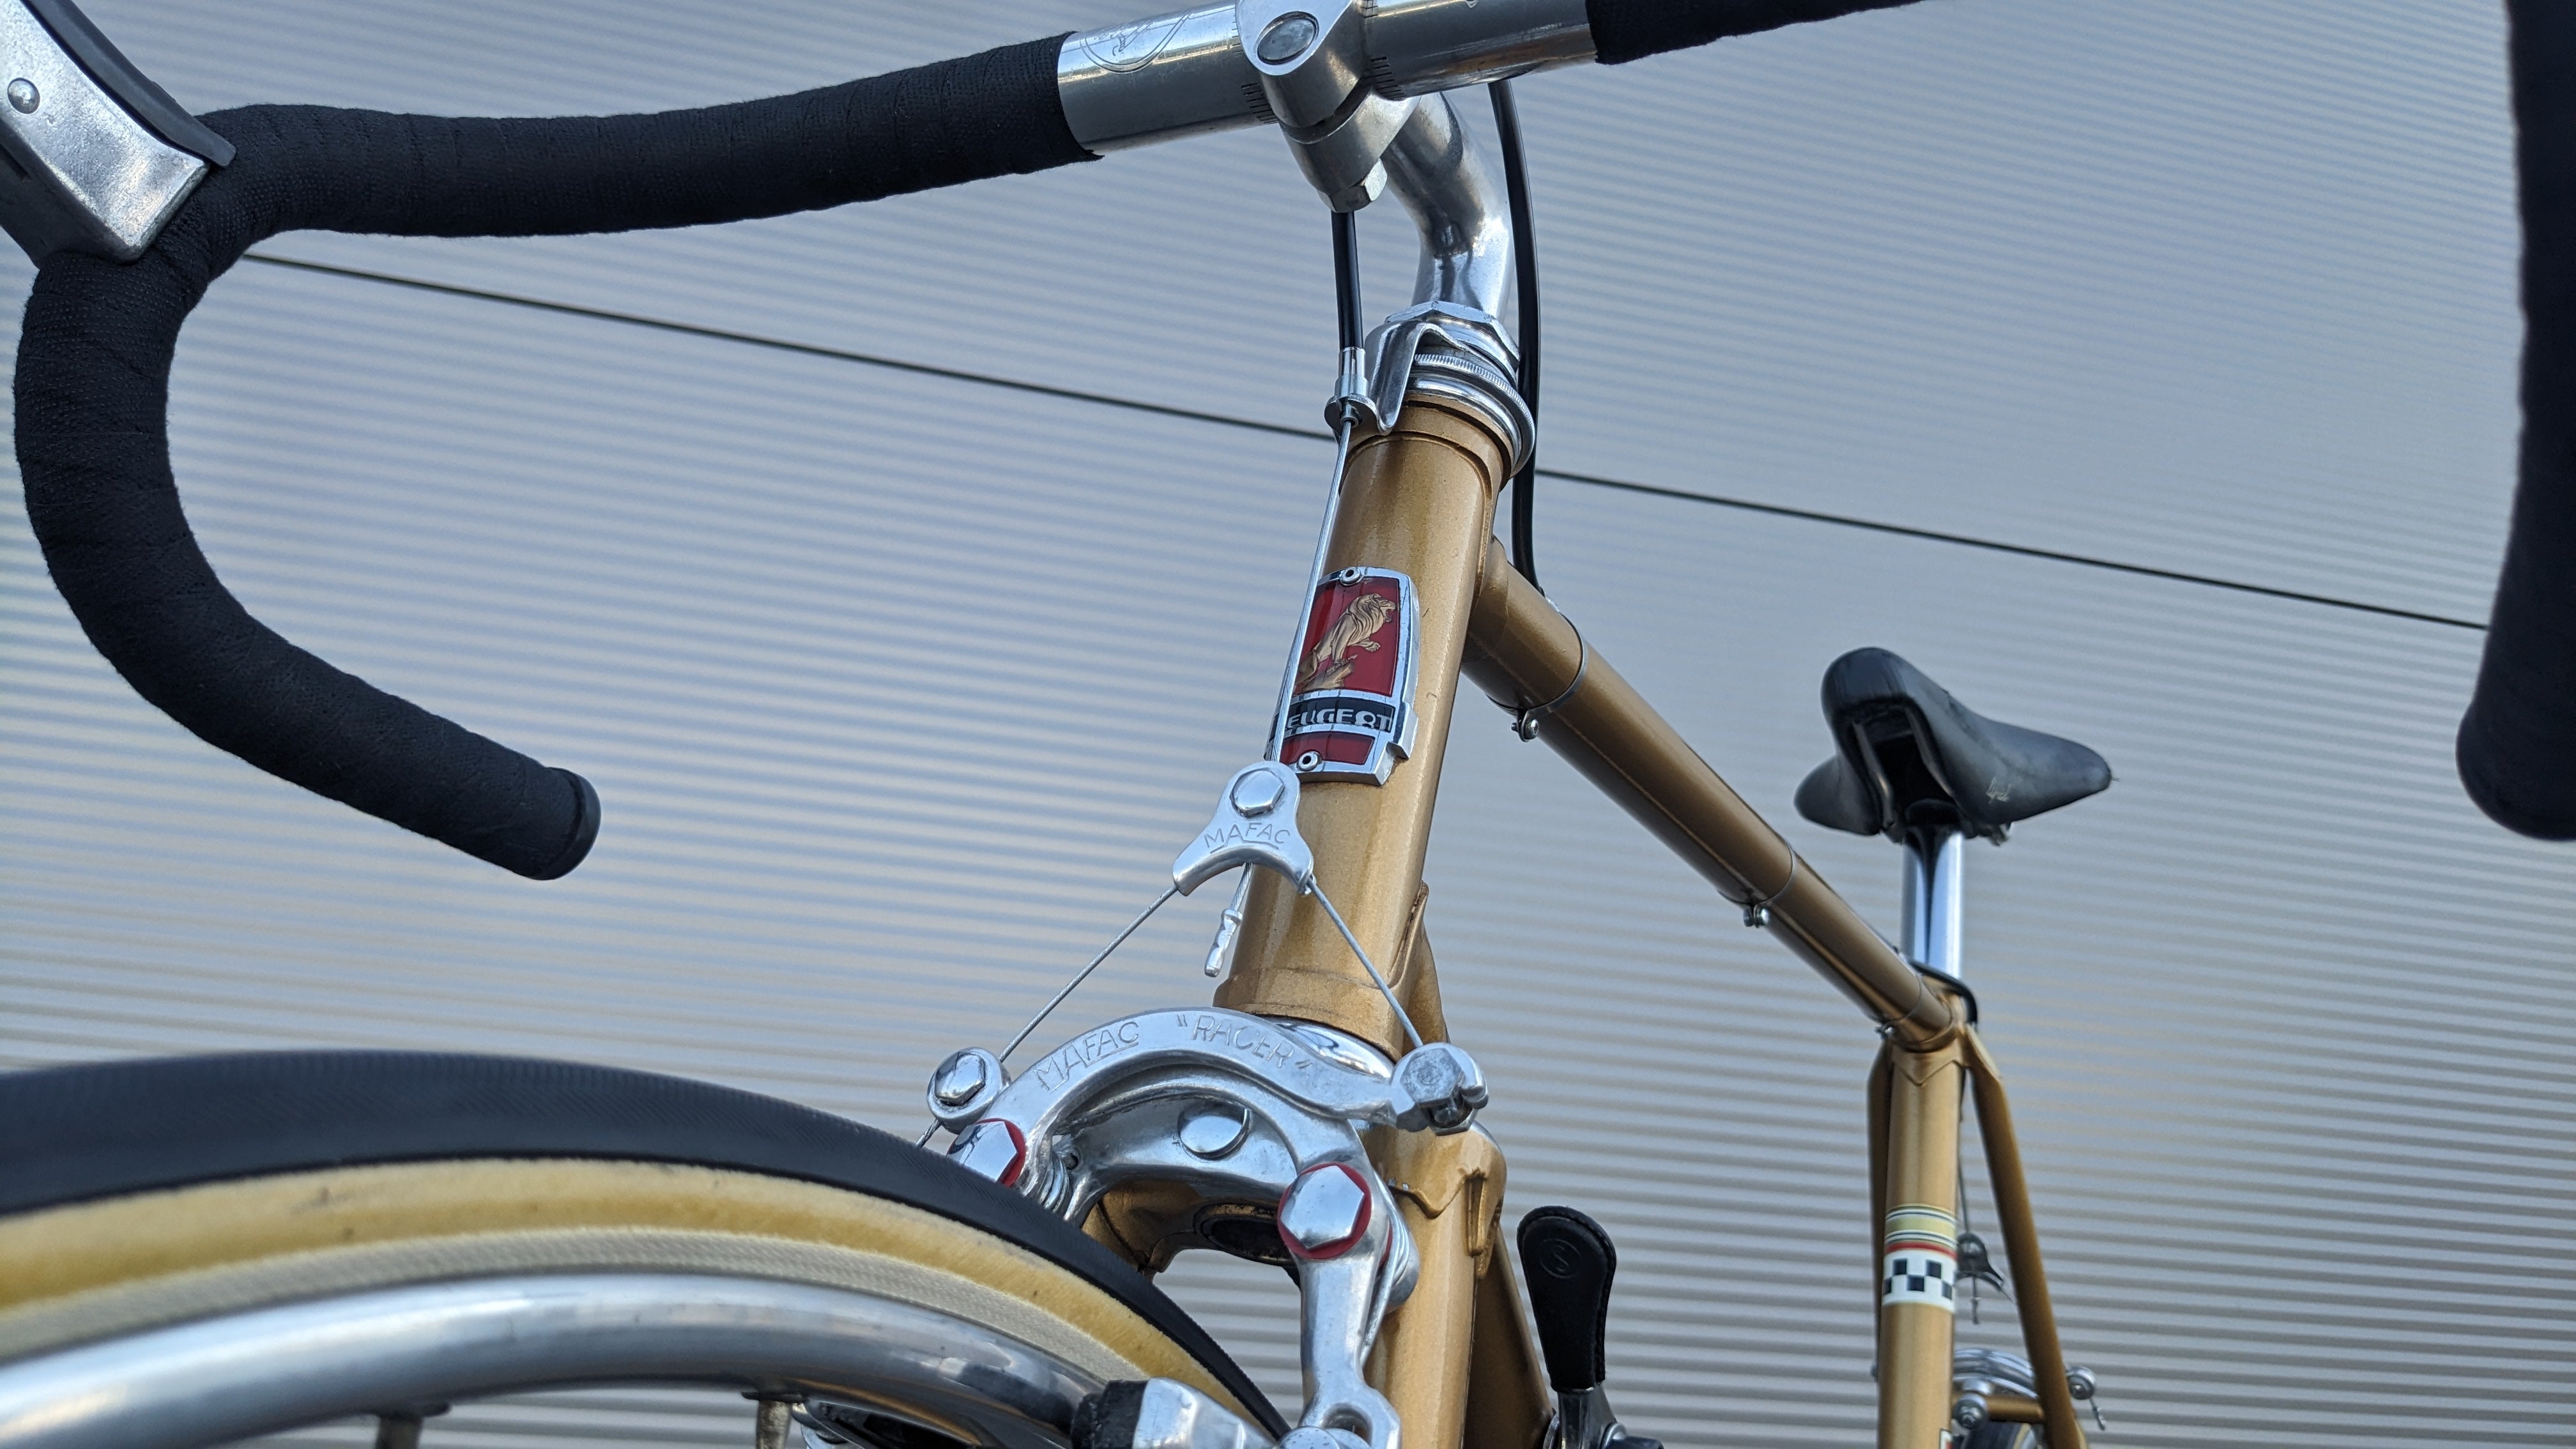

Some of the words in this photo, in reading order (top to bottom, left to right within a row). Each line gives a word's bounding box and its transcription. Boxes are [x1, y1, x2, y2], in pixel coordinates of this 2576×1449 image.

[1284, 707, 1392, 732] EUGEOT
[1203, 822, 1291, 850] MAFAC
[1032, 1021, 1140, 1092] MAFAC
